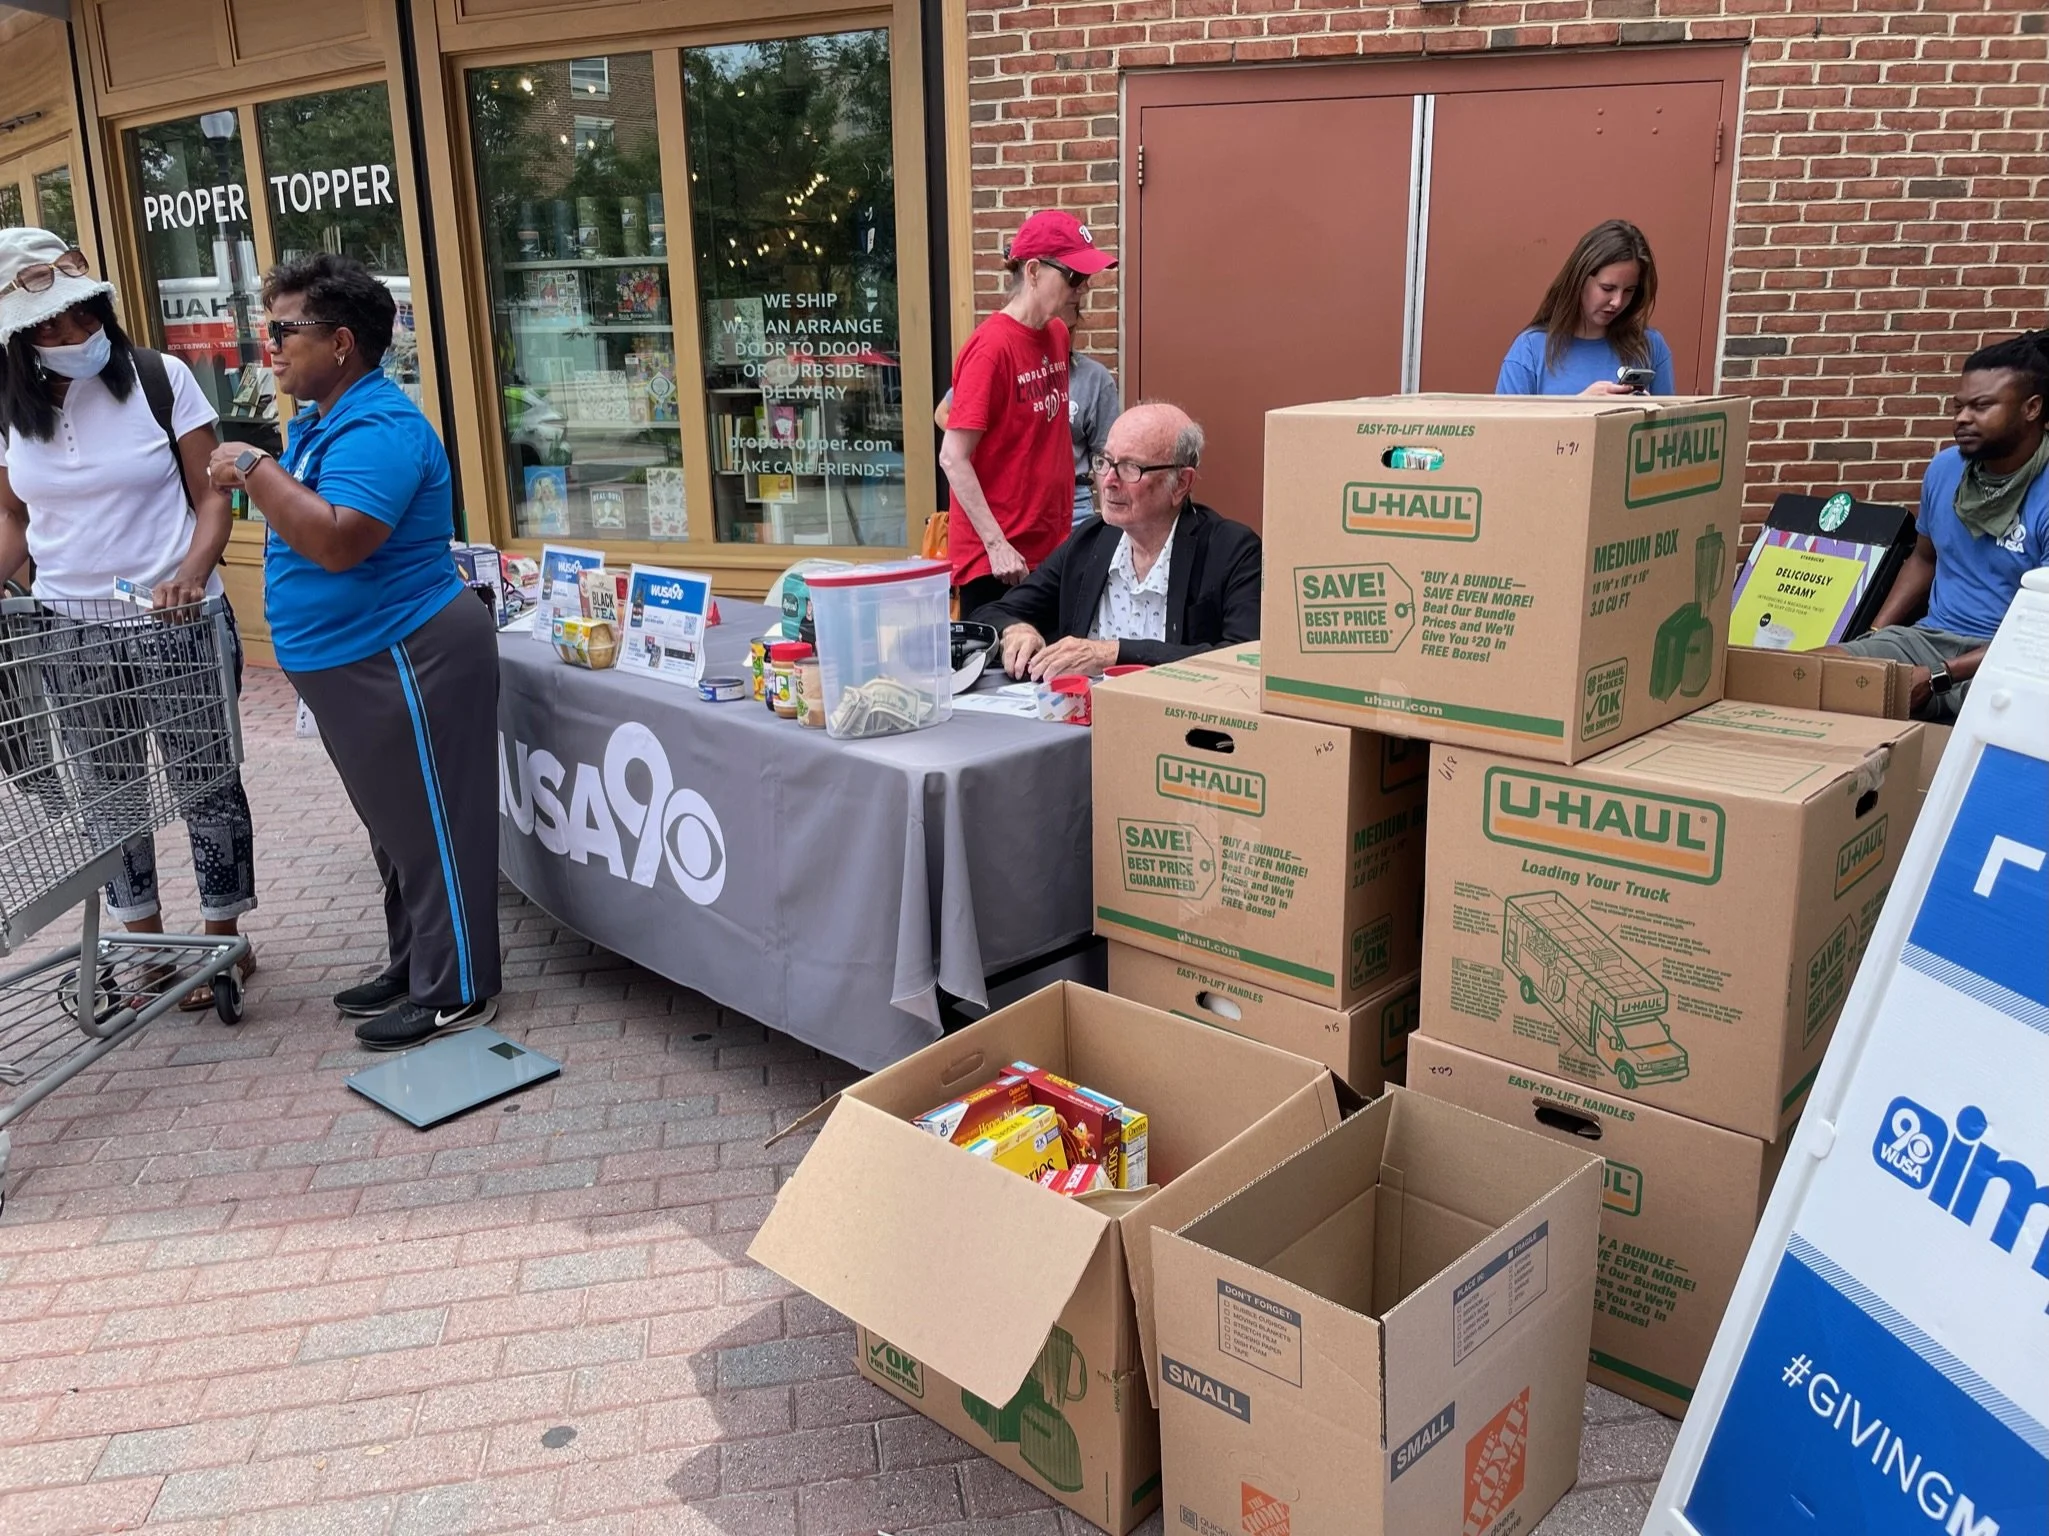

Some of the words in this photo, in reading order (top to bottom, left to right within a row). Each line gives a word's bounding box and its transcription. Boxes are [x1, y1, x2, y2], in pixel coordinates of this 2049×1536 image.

[144, 184, 248, 231] PROPER
[270, 164, 394, 214] TOPPER
[764, 293, 792, 308] WE
[796, 293, 838, 308] SHIP
[723, 319, 753, 334] WE
[756, 319, 791, 334] CAN
[795, 319, 884, 334] ARRANGE
[735, 342, 786, 357] DOOR
[789, 341, 814, 356] TO
[819, 341, 873, 356] DOOR
[743, 363, 768, 378] OR
[776, 363, 866, 379] CURBSIDE
[1018, 366, 1047, 384] WORLD
[762, 385, 848, 400] DELIVERY
[1357, 424, 1424, 436] EASY-TO-LIFT
[1425, 424, 1475, 437] HANDLES
[729, 436, 893, 455] propertopper.com
[1635, 426, 1721, 474] U-HAUL
[733, 460, 770, 474] TAKE
[774, 460, 813, 474] CARE
[818, 463, 890, 477] FRIENDS!
[1352, 491, 1472, 520] U-HAUL
[1593, 535, 1651, 574] MEDIUM
[1654, 529, 1679, 559] BOX
[1302, 572, 1386, 600] SAVE!
[1450, 574, 1460, 585] A
[1775, 567, 1834, 587] DELICIOUSLY
[591, 592, 615, 609] BLACK
[1423, 587, 1454, 600] SAVE
[1456, 590, 1489, 603] EVEN
[1491, 594, 1534, 608] MORE!
[1777, 583, 1817, 599] DREAMY
[593, 606, 616, 621] TEA
[1423, 602, 1448, 615] Beat
[1450, 606, 1472, 618] Our
[1474, 608, 1516, 622] Bundle
[1589, 599, 1604, 617] 3.0
[1606, 595, 1618, 612] CU
[1619, 592, 1631, 609] FT
[1304, 612, 1339, 627] BEST
[1343, 610, 1387, 626] PRICE
[1422, 617, 1457, 630] Prices
[1459, 620, 1482, 632] and
[1485, 623, 1515, 637] We'll
[1421, 631, 1447, 644] Give
[1449, 633, 1470, 646] You
[1472, 635, 1491, 649] $20
[1494, 638, 1507, 651] in
[1421, 644, 1449, 657] FREE
[1451, 648, 1490, 663] Boxes!
[1597, 677, 1624, 693] BOXES
[1364, 694, 1443, 716] uhaul.com
[1598, 690, 1621, 717] OK
[1165, 707, 1218, 725] EASY-TO-LIFT
[1219, 716, 1259, 731] HANDLES
[1584, 722, 1595, 735] FOR
[1595, 713, 1620, 733] SHIPPING
[1163, 762, 1258, 799] U-HAUL
[1500, 780, 1706, 850] U-HAUL
[1126, 826, 1192, 852] SAVE!
[1243, 840, 1250, 851] A
[1839, 823, 1885, 877] U-HAUL
[1128, 857, 1156, 872] BEST
[1159, 859, 1193, 876] PRICE
[1221, 849, 1246, 863] SAVE
[1248, 855, 1273, 870] EVEN
[1274, 861, 1308, 878] MORE!
[1221, 862, 1242, 874] Beat
[1243, 867, 1260, 880] Our
[1261, 871, 1295, 888] Bundle
[1251, 880, 1269, 892] and
[1270, 884, 1294, 899] We'll
[1521, 859, 1580, 886] Loading
[1586, 873, 1621, 894] Your
[1625, 880, 1671, 903] Truck
[1221, 897, 1244, 910] FREE
[1246, 902, 1276, 918] Boxes!
[1243, 890, 1260, 903] You
[1261, 893, 1276, 906] $20
[1177, 931, 1241, 958] uhaul.com
[1810, 925, 1848, 988] SAVE!
[1177, 966, 1226, 992] EASY-TO-LIFT
[1227, 984, 1263, 1004] HANDLES
[1807, 990, 1823, 1019] BEST
[1826, 967, 1844, 993] PRICE
[1622, 998, 1662, 1013] U-HAUL
[1507, 1074, 1581, 1102] EASY-TO-LIFT
[1583, 1098, 1636, 1122] HANDLES
[1034, 1139, 1046, 1149] 2X
[1880, 1142, 1924, 1183] WUSA
[1928, 1105, 2049, 1300] im
[1514, 1232, 1537, 1255] FRAGILE
[1608, 1235, 1618, 1251] A
[1608, 1267, 1630, 1283] Our
[1633, 1273, 1678, 1299] Bundle
[1614, 1253, 1650, 1276] EVEN
[1652, 1268, 1697, 1292] MORE!
[1457, 1277, 1476, 1298] PLACE
[1617, 1283, 1641, 1299] and
[1644, 1292, 1676, 1313] We'll
[1225, 1285, 1252, 1302] DON'T
[1254, 1296, 1293, 1321] FORGET:
[1606, 1291, 1628, 1308] You
[1630, 1300, 1650, 1316] $20
[1653, 1307, 1668, 1322] in
[1233, 1304, 1257, 1320] BUBBLE
[1258, 1315, 1287, 1332] CUSHION
[1608, 1303, 1650, 1328] Boxes!
[1233, 1313, 1258, 1327] MOVING
[1259, 1322, 1291, 1343] BLANKETS
[1233, 1321, 1262, 1337] STRETCH
[1263, 1333, 1277, 1345] FILM
[1233, 1329, 1260, 1346] PACKING
[1261, 1341, 1282, 1356] PAPER
[1234, 1337, 1248, 1349] DISH
[1249, 1345, 1267, 1357] FOAM
[1234, 1346, 1249, 1358] TAPE
[870, 1358, 885, 1373] FOR
[885, 1367, 920, 1393] SHIPPING
[885, 1350, 919, 1382] OK
[1168, 1364, 1242, 1414] SMALL
[1396, 1414, 1449, 1471] SMALL
[1463, 1396, 1528, 1536] HOME
